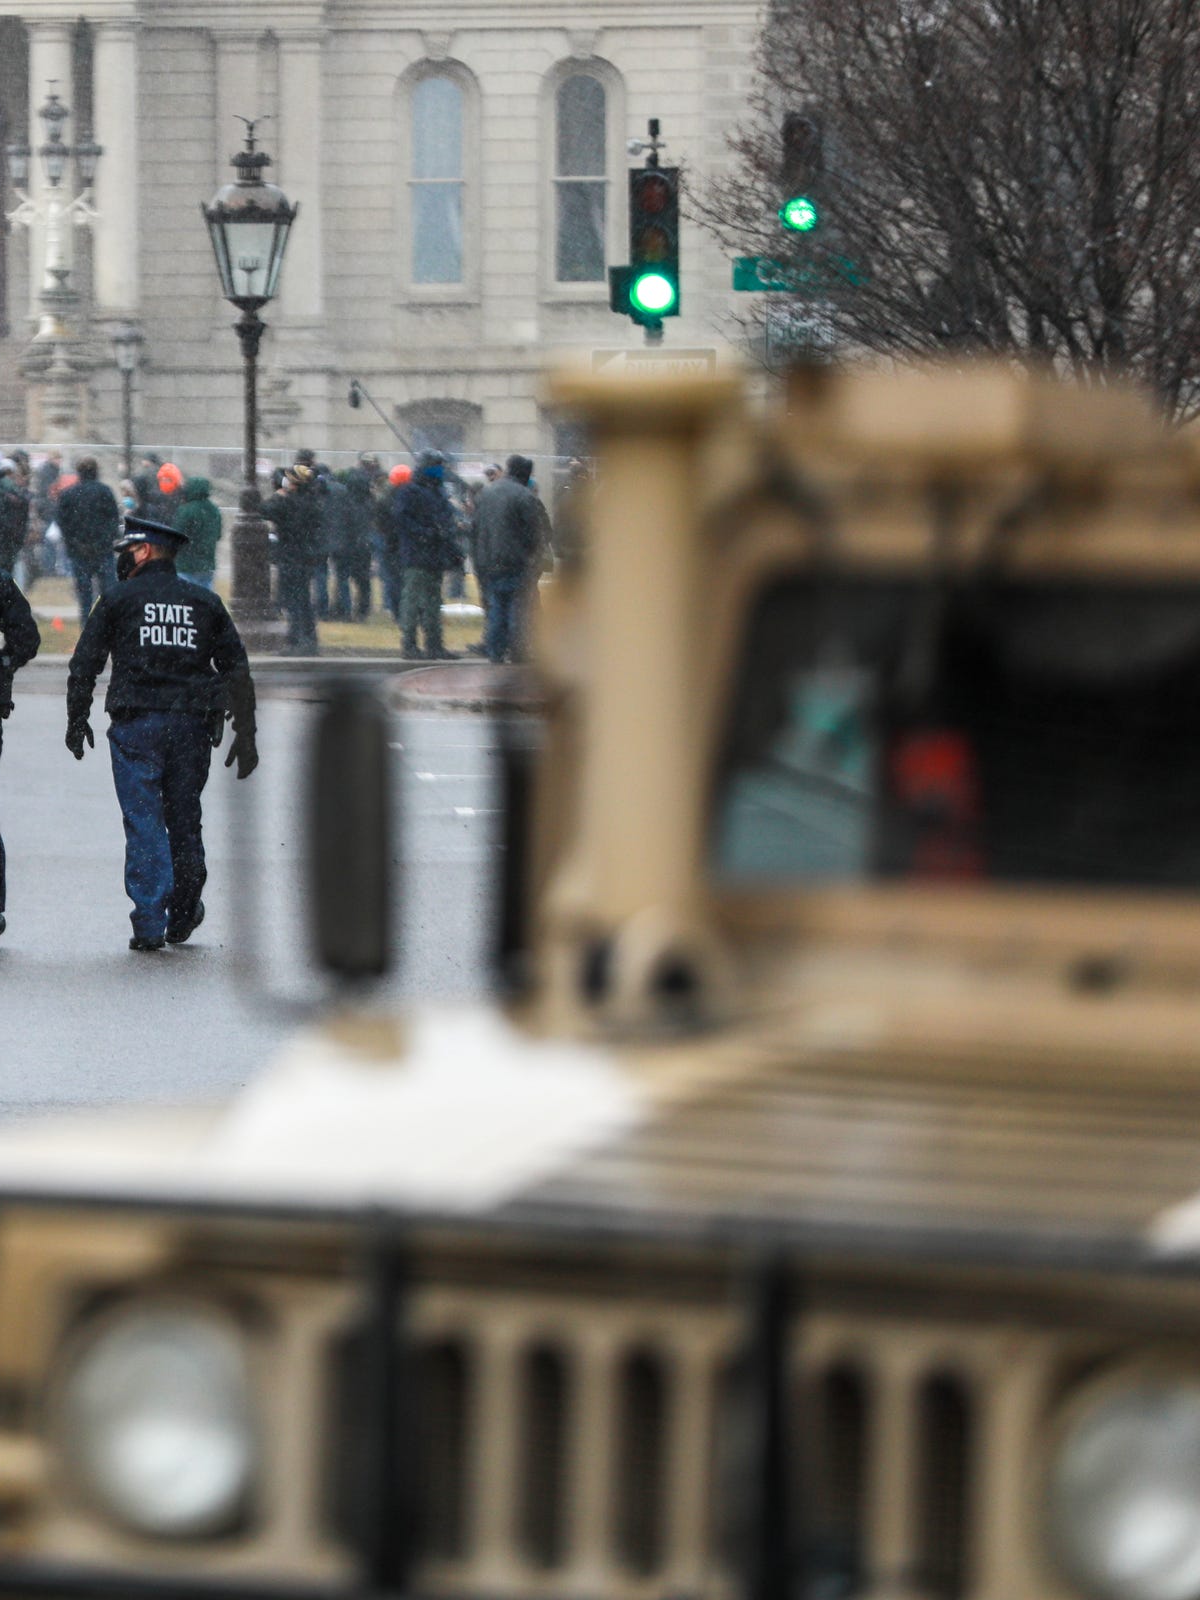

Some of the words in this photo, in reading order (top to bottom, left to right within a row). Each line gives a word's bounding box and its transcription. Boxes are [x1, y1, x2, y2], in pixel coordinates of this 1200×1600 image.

[666, 360, 702, 376] WAY
[144, 602, 194, 626] STATE
[139, 625, 197, 648] POLICE
